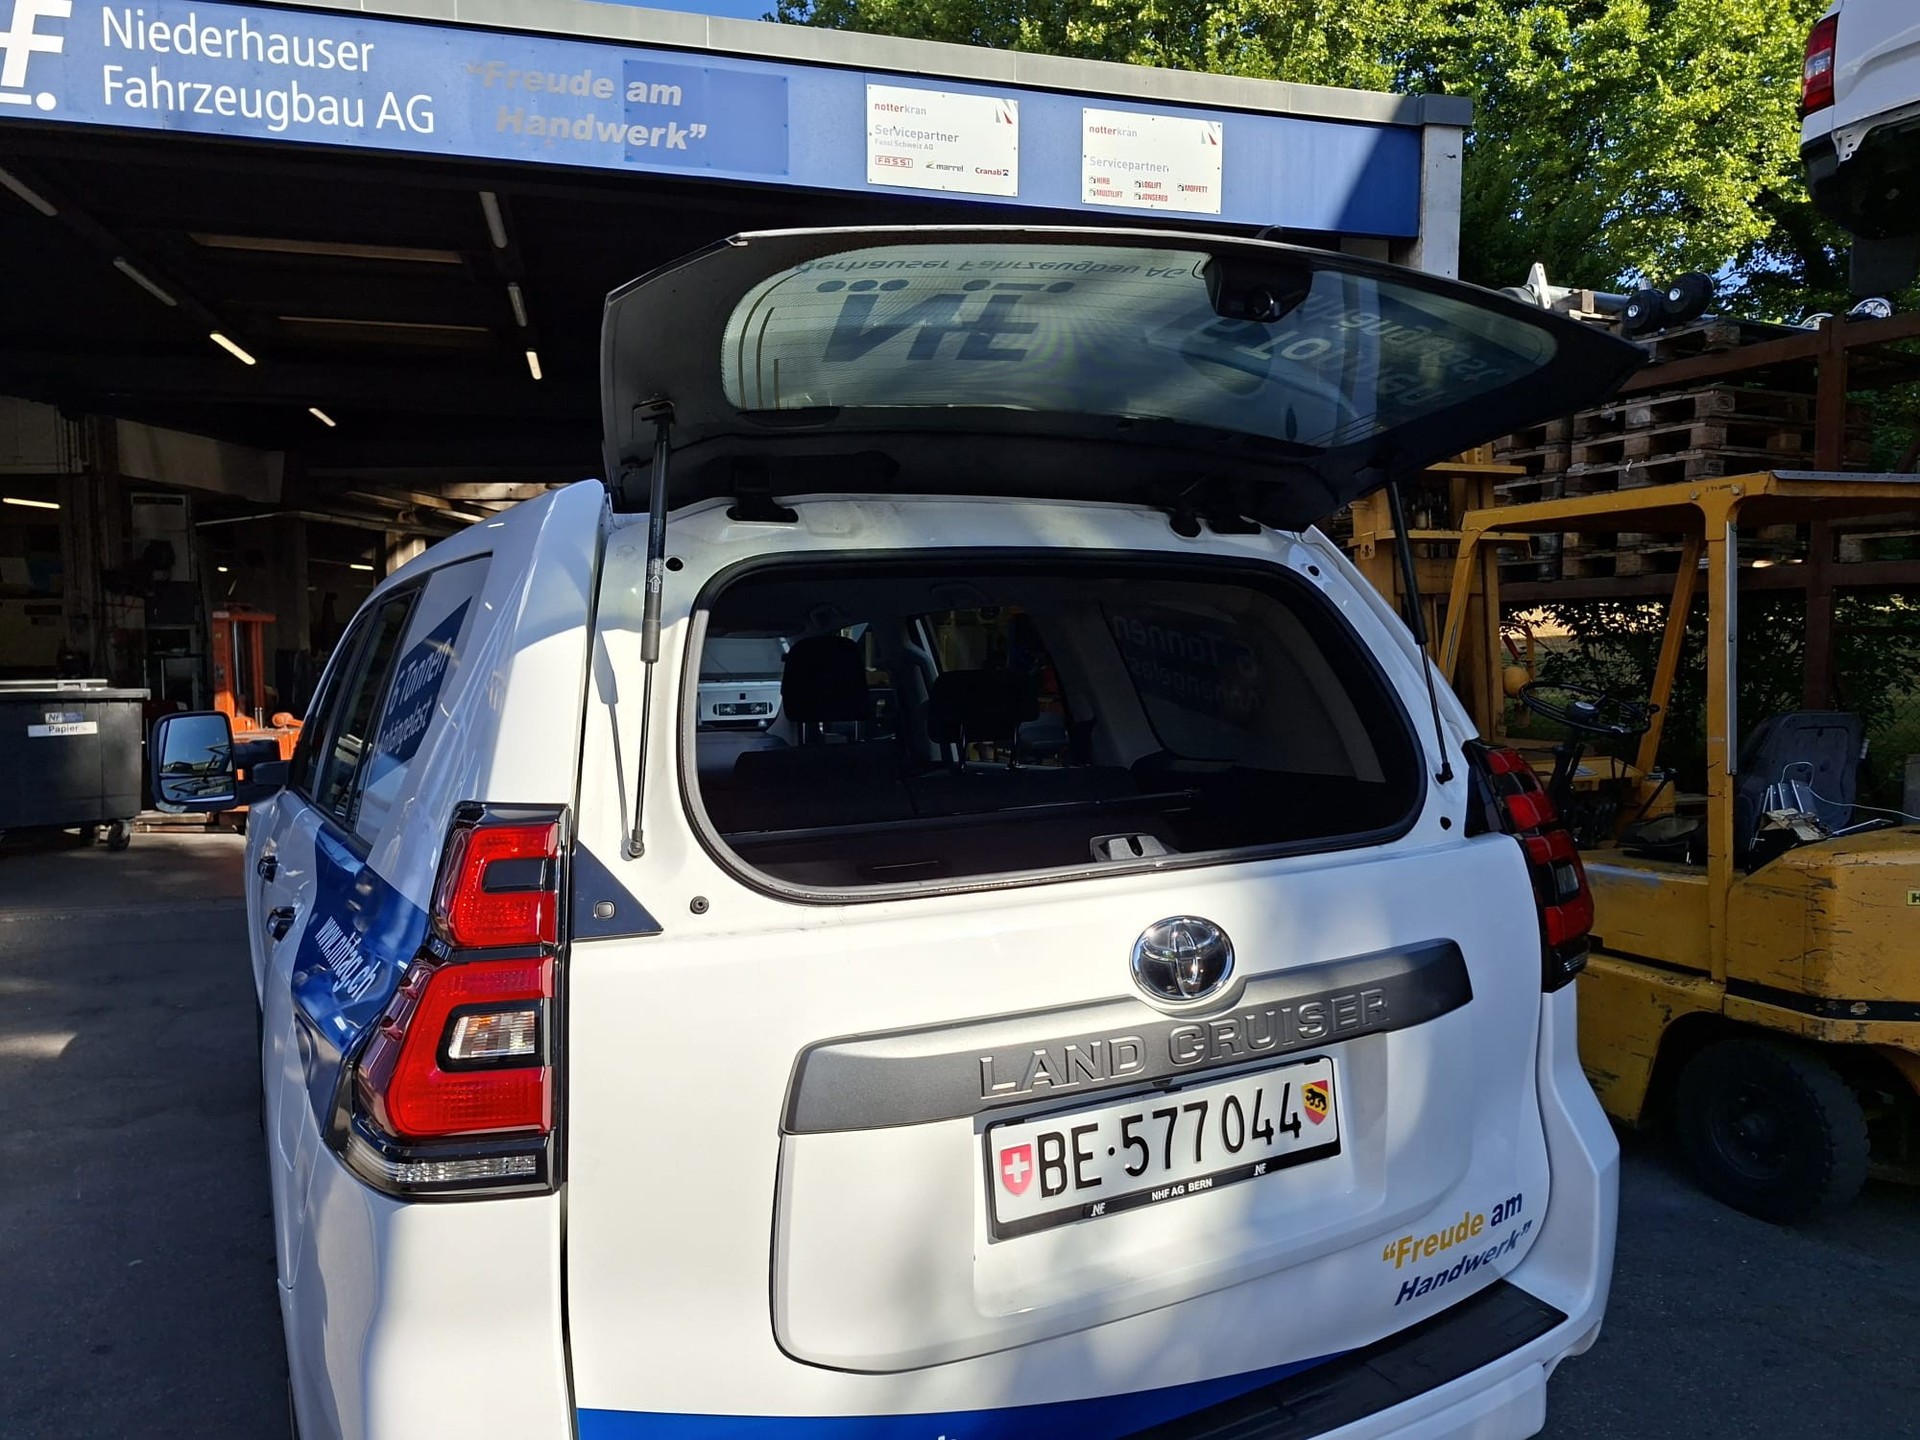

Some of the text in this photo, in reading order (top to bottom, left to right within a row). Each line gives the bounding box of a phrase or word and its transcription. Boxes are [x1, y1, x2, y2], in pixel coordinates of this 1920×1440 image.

[102, 7, 374, 72] Niederhauser
[102, 65, 434, 134] Fahrzeugbau AG
[626, 79, 682, 106] am
[874, 102, 927, 116] notterkran
[875, 124, 959, 143] Servicepartner
[1089, 125, 1138, 138] notterkran
[924, 143, 934, 151] AG
[877, 157, 911, 167] FASSI
[936, 163, 964, 173] marrel
[1089, 156, 1169, 173] Servicepartner
[975, 167, 1002, 176] Cranab
[48, 725, 78, 734] Papier
[314, 915, 381, 1003] www.nhfag.ch
[978, 987, 1390, 1100] LAND CRUISER
[1152, 1178, 1213, 1201] NHF AG BERN
[1490, 1193, 1523, 1227] am
